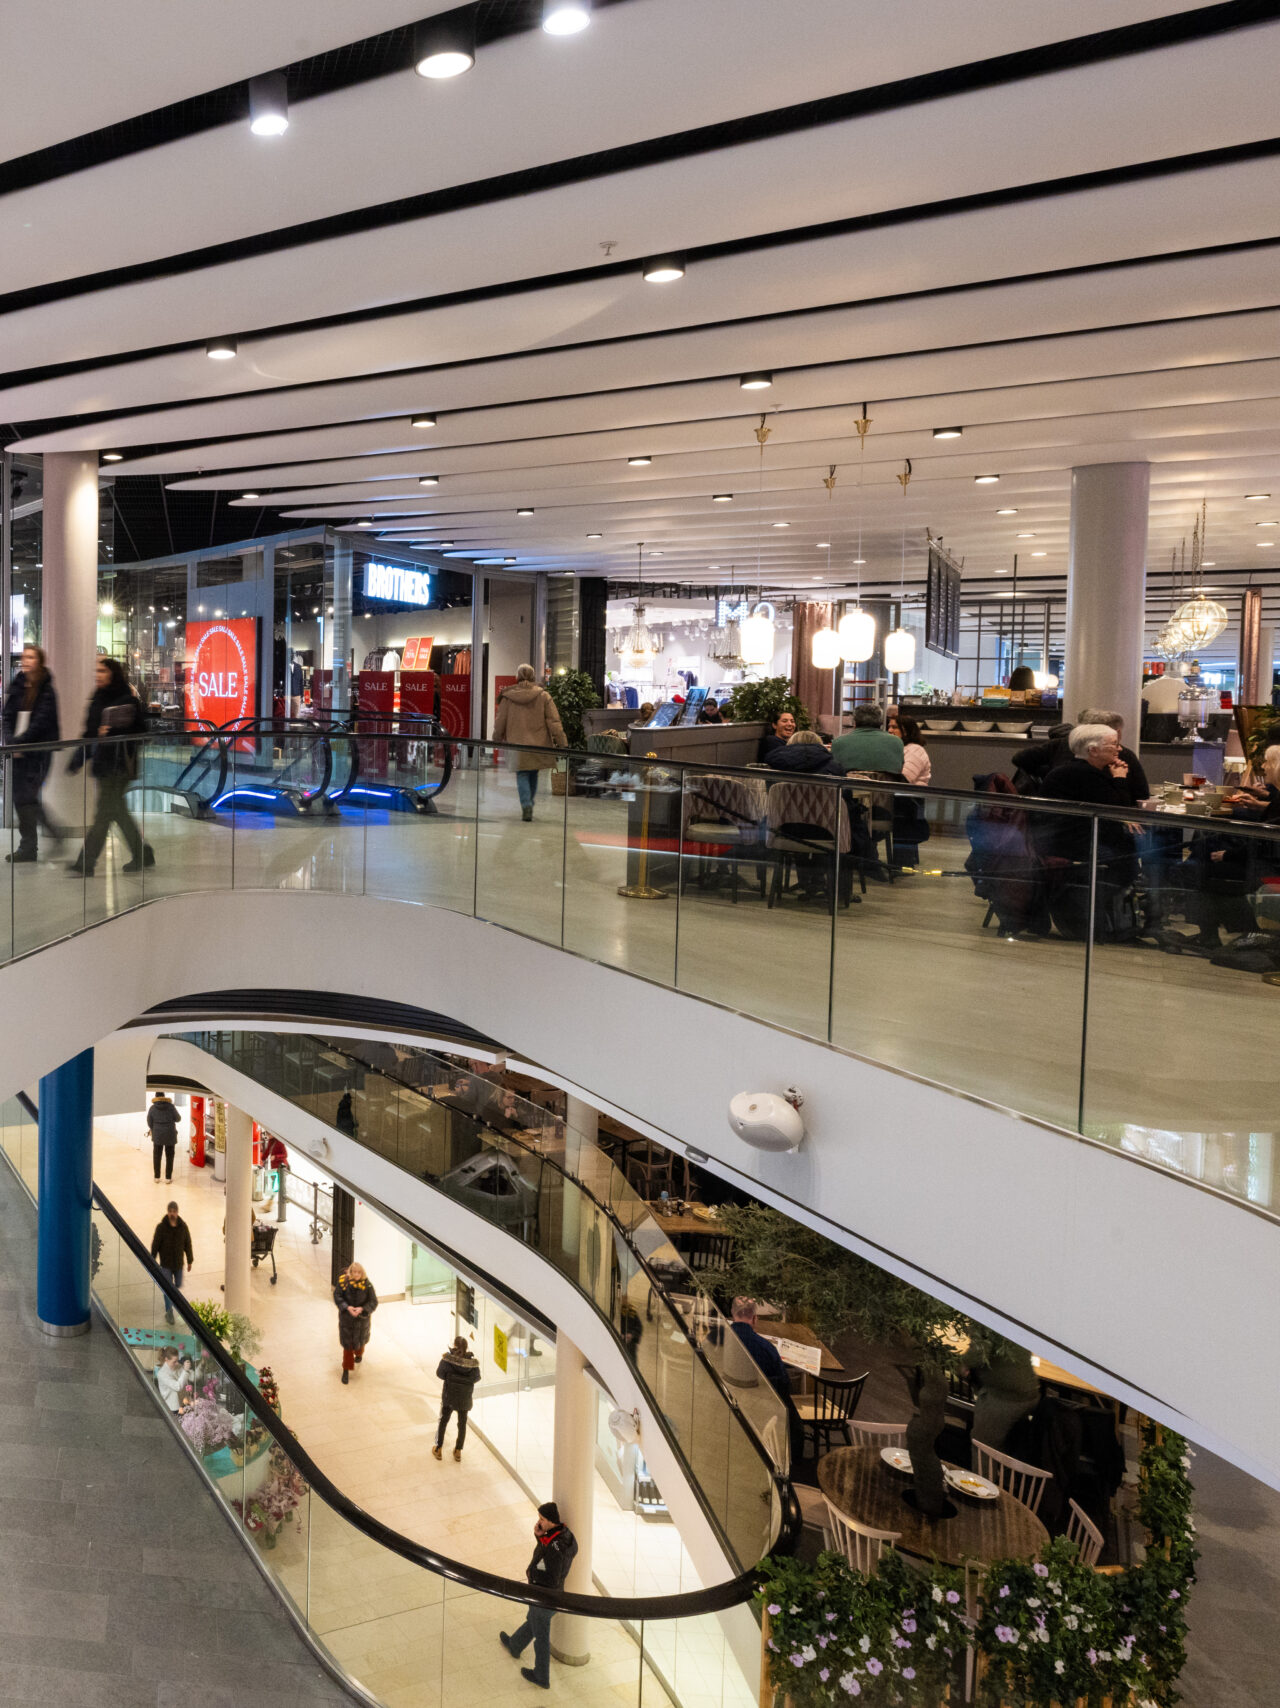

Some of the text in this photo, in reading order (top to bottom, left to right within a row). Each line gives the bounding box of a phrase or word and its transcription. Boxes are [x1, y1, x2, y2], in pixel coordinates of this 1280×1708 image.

[367, 562, 430, 606] BROTHERS
[199, 672, 238, 698] SALE
[364, 682, 388, 691] SALE
[405, 683, 428, 692] SALE
[445, 684, 467, 693] SALE
